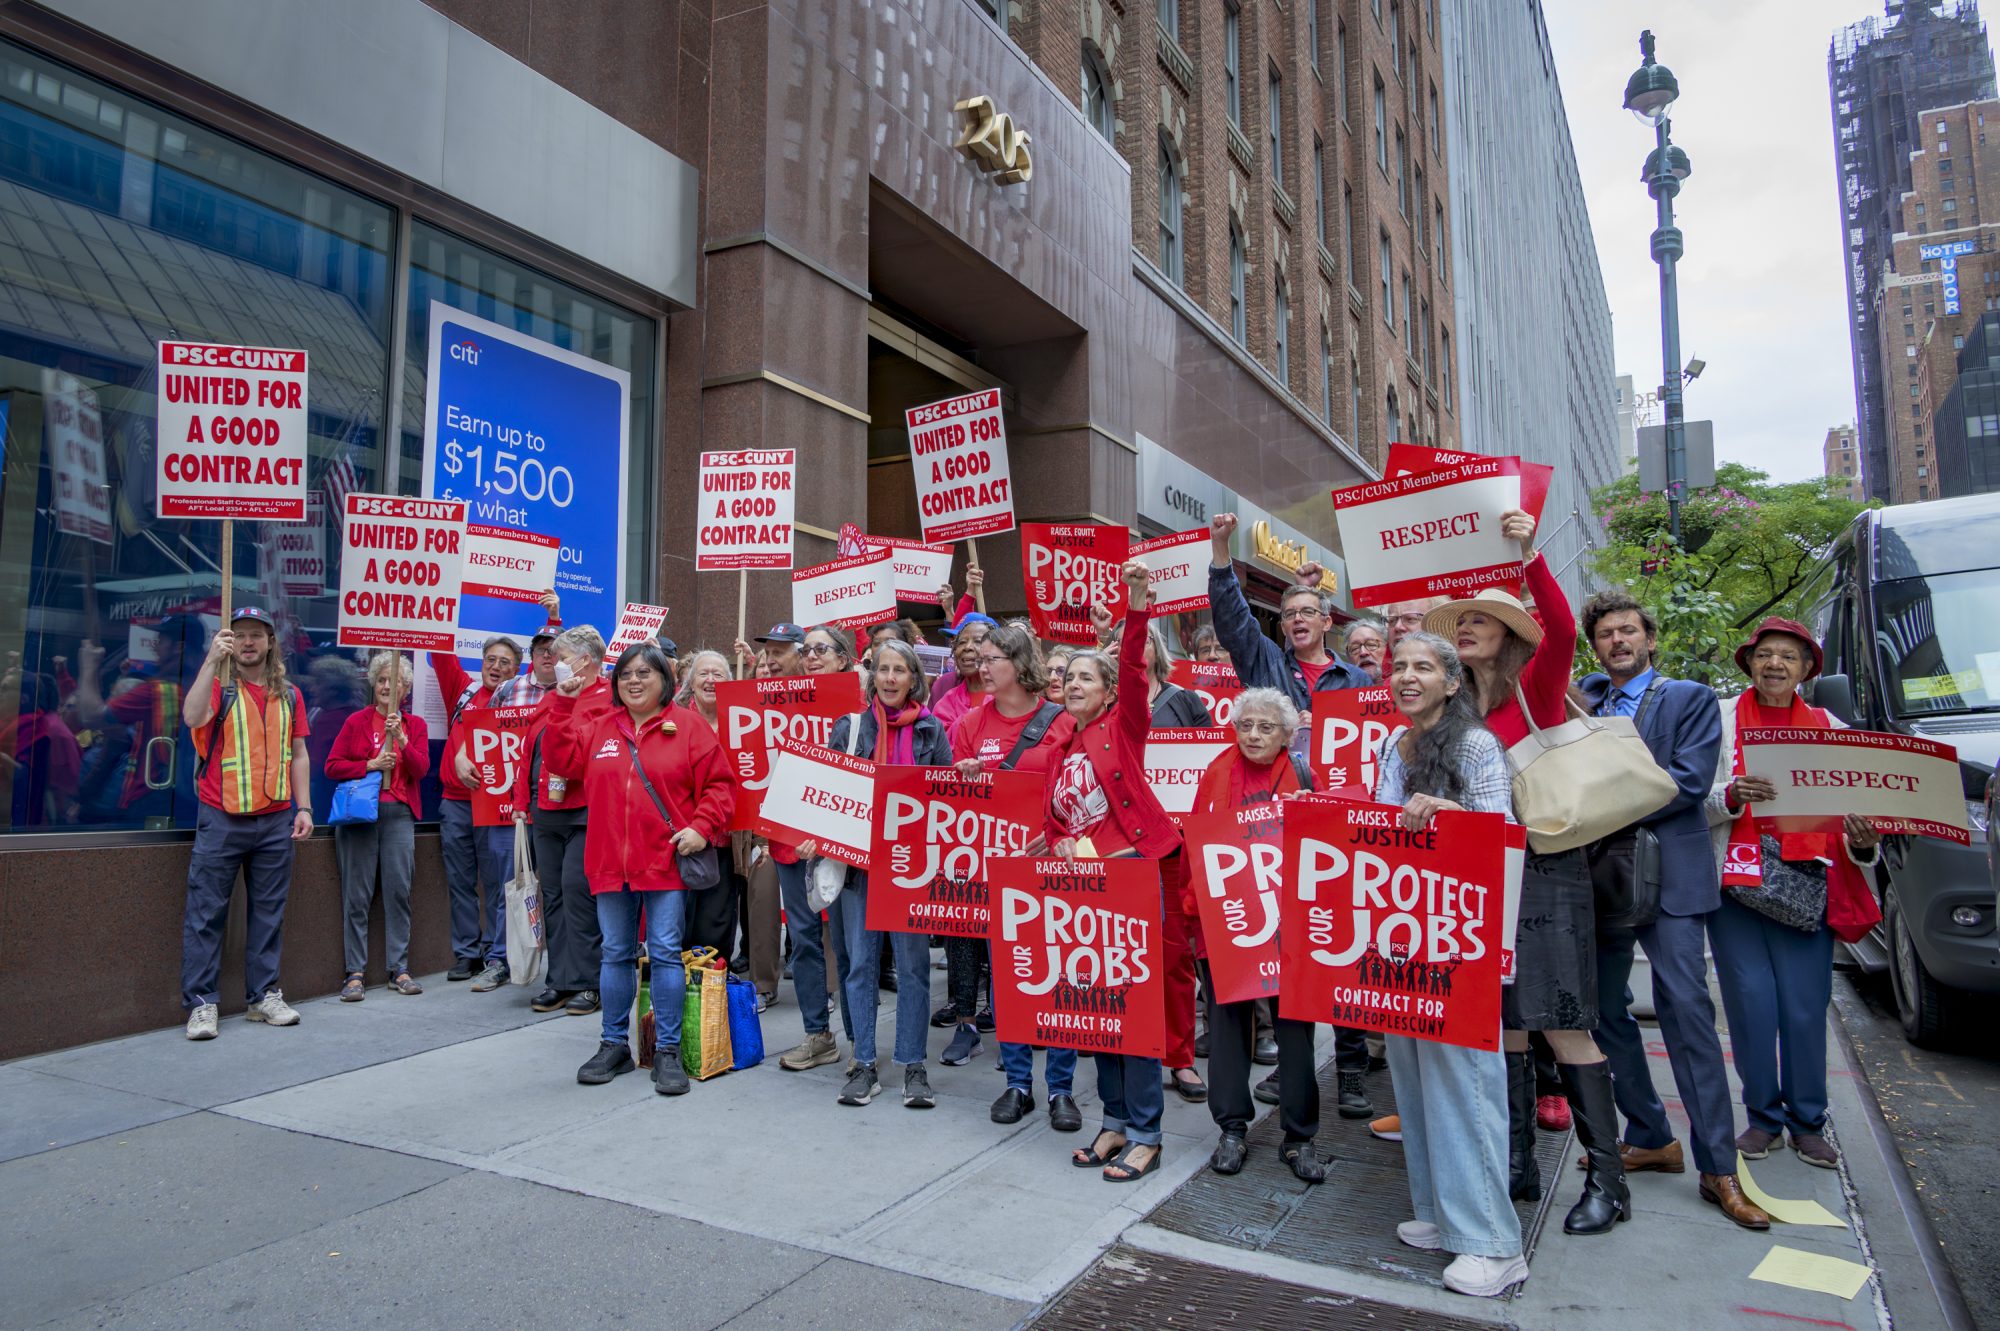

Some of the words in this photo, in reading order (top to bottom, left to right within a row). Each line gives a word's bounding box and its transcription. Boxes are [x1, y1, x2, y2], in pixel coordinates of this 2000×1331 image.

[1921, 244, 1972, 257] HOTEL
[173, 346, 296, 370] PSC-CUNY
[450, 341, 480, 366] citi
[166, 374, 250, 406] UNITED
[259, 380, 303, 409] FOR
[915, 393, 991, 424] PSC-CUNY
[186, 415, 205, 443] A
[211, 416, 280, 447] GOOD
[447, 405, 492, 438] Earn
[497, 424, 522, 451] up
[525, 431, 545, 452] to
[913, 424, 965, 456] UNITED
[969, 416, 1001, 443] FOR
[164, 453, 303, 486] CONTRACT
[709, 452, 787, 466] PSC-CUNY
[932, 461, 943, 484] A
[945, 451, 990, 481] GOOD
[443, 439, 573, 507] $1,500
[703, 471, 757, 492] UNITED
[761, 471, 791, 491] FOR
[1336, 481, 1400, 504] PSC/CUNY
[1402, 469, 1458, 490] Members
[1460, 462, 1498, 477] Want
[715, 499, 726, 518] A
[731, 497, 776, 519] GOOD
[921, 478, 1008, 517] CONTRACT
[1164, 485, 1206, 523] COFFEE
[356, 499, 456, 520] PSC-CUNY
[478, 500, 528, 528] what
[349, 522, 421, 550] UNITED
[423, 528, 459, 555] FOR
[492, 527, 529, 540] Members
[530, 534, 549, 544] Want
[700, 524, 791, 546] CONTRACT
[1051, 527, 1073, 537] RAISES,
[1074, 528, 1096, 537] EQUITY,
[1052, 537, 1096, 547] JUSTICE
[1379, 511, 1480, 551] RESPECT
[895, 540, 926, 550] Members
[1128, 545, 1144, 555] CUNY
[1144, 537, 1177, 550] Members
[1177, 532, 1199, 542] Want
[469, 553, 535, 573] RESPECT
[558, 546, 582, 565] ou
[793, 565, 829, 579] PSC/CUNY
[830, 556, 865, 570] Members
[866, 552, 885, 562] Want
[1029, 543, 1121, 583] PROTECT
[364, 557, 379, 583] A
[384, 559, 441, 587] GOOD
[563, 572, 570, 581] by
[569, 573, 592, 584] opening
[893, 563, 931, 576] SPECT
[1149, 563, 1190, 584] SPECT
[1427, 565, 1524, 591] #APeoplesCUNY
[487, 588, 541, 601] #APeoplesCU
[557, 580, 579, 591] required
[814, 581, 876, 606] RESPECT
[896, 591, 939, 601] APeoplesCU
[1035, 580, 1047, 600] OUR
[1038, 580, 1120, 611] JOBS
[344, 590, 457, 623] CONTRACT
[630, 604, 663, 616] PSC-CUNY
[1156, 597, 1210, 614] #APeoplesCUN
[622, 614, 646, 626] UNITED
[646, 617, 661, 629] FOR
[841, 609, 896, 628] APeoplesCUNY
[1049, 621, 1083, 634] CONTRACT
[621, 629, 628, 639] A
[628, 629, 648, 641] GOOD
[1192, 665, 1220, 676] RAISES,
[757, 680, 786, 693] RAISES,
[788, 678, 816, 691] EQUITY,
[1192, 675, 1239, 689] JUSTIC
[760, 690, 816, 706] JUSTICE
[1358, 688, 1390, 703] RAISES,
[495, 709, 518, 719] RAISES,
[728, 705, 834, 749] PROTE
[1196, 731, 1225, 740] Want
[1744, 730, 1819, 742] PSC/CUNY
[1823, 731, 1894, 746] Members
[1896, 738, 1937, 753] Want
[738, 751, 756, 777] OUR
[785, 738, 842, 764] PSC/CUNY
[842, 756, 876, 775] Memb
[482, 764, 496, 785] OUR
[925, 770, 958, 783] RAISES,
[1144, 768, 1206, 785] SPECT
[1790, 769, 1919, 793] RESPECT
[925, 783, 993, 800] JUSTICE
[801, 785, 873, 822] RESPE
[883, 792, 1030, 853] PROTECT
[1237, 806, 1276, 825] RAISES,
[1347, 809, 1392, 829] RAISES,
[1349, 827, 1437, 850] JUSTICE
[1867, 820, 1967, 841] PeoplesCUNY
[891, 844, 911, 873] OUR
[1036, 862, 1072, 876] RAISES,
[1073, 863, 1106, 877] EQUITY,
[955, 868, 968, 876] PSC
[1298, 837, 1488, 919] PROTECT
[1040, 876, 1106, 893] JUSTICE
[909, 903, 968, 919] CONTRACT
[1001, 887, 1149, 949] PROTECT
[1222, 897, 1249, 932] OUR
[908, 917, 989, 934] #APEOPLESCUN
[1309, 905, 1333, 945] OUR
[1310, 909, 1487, 967] JOBS
[1391, 943, 1409, 953] PSC
[1013, 945, 1032, 978] OUR
[1016, 945, 1151, 996] JOBS
[1077, 972, 1090, 980] PSC
[1334, 987, 1410, 1012] CONTRACT
[1417, 998, 1444, 1018] FOR
[1036, 1011, 1095, 1032] CONTRACT
[1100, 1017, 1121, 1033] FOR
[1333, 1005, 1445, 1037] #APEOPLESCUNY
[1036, 1026, 1124, 1050] #APEOPLESCUNY
